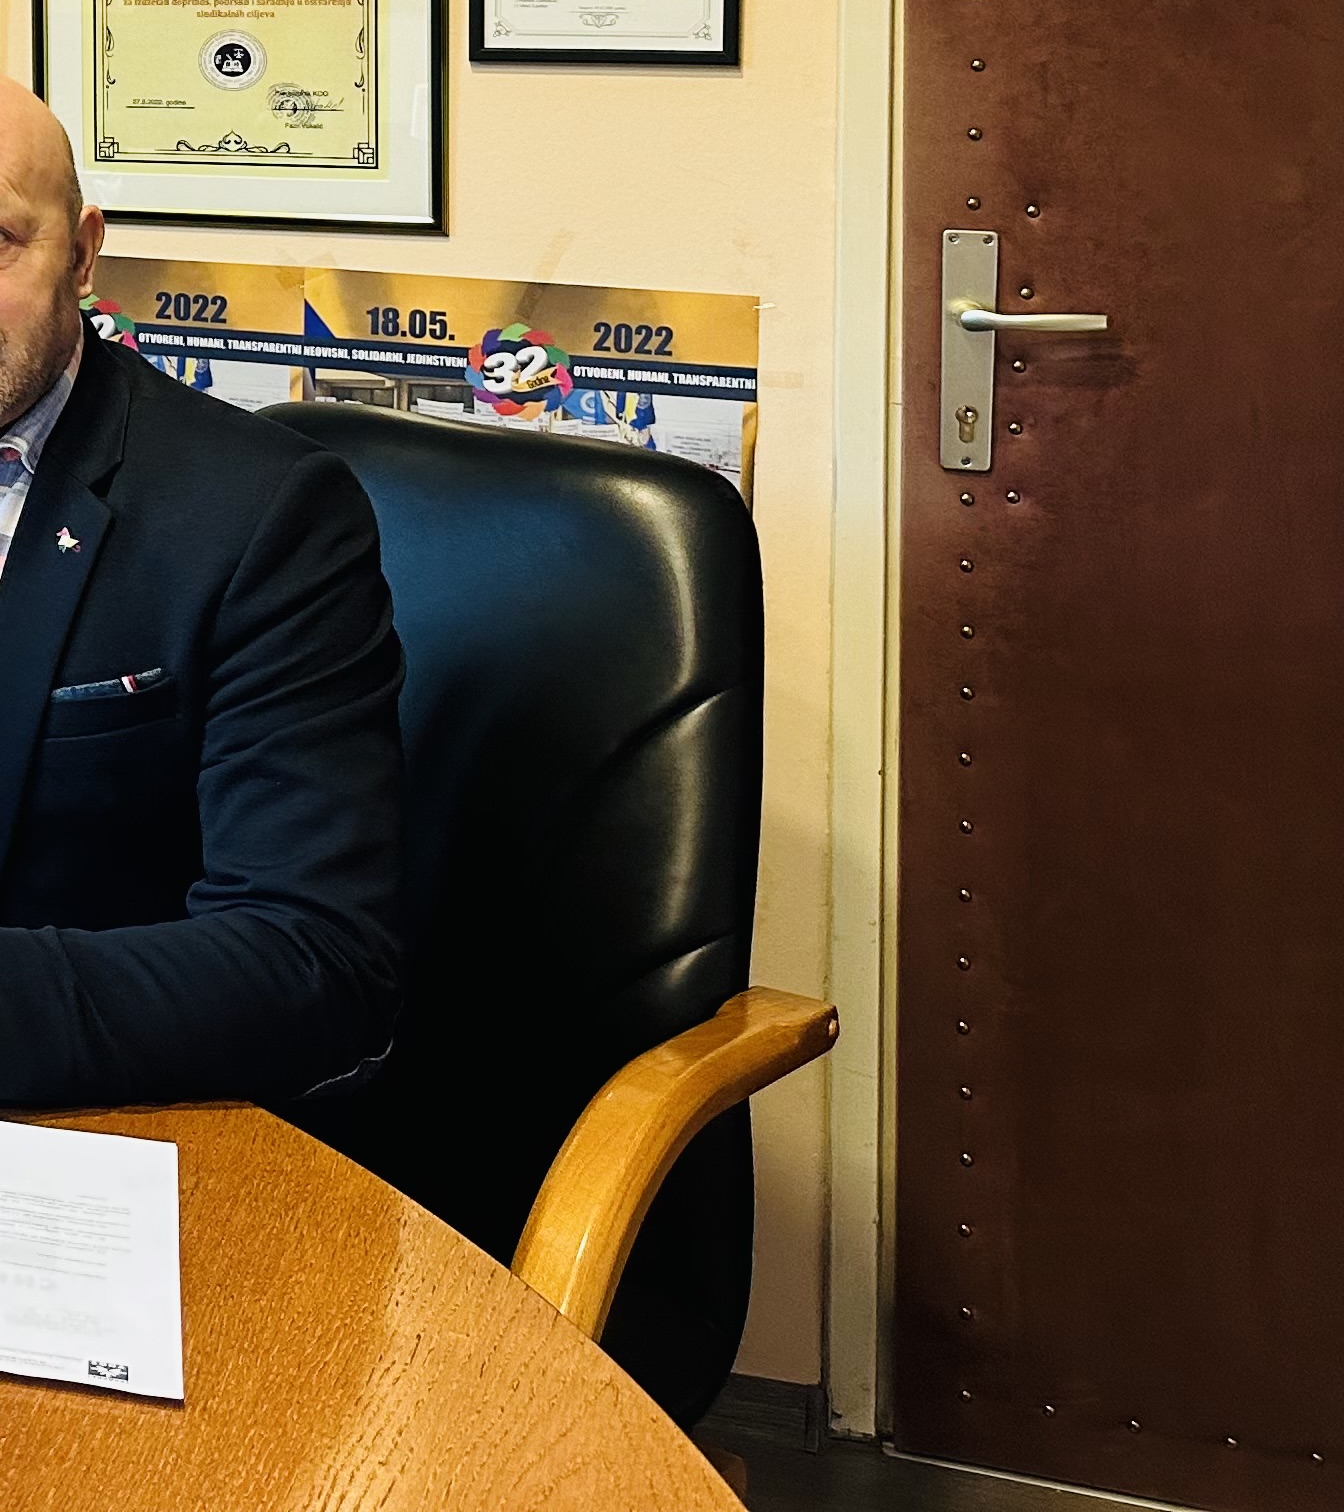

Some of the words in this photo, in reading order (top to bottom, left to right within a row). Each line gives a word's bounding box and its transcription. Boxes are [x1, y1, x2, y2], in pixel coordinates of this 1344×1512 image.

[155, 292, 228, 324] 2022
[228, 337, 302, 356] TRANSPARENTNI
[366, 306, 455, 342] 18.05.
[593, 321, 674, 357] 2022
[483, 346, 549, 395] 32
[573, 365, 626, 381] OTVORENI,
